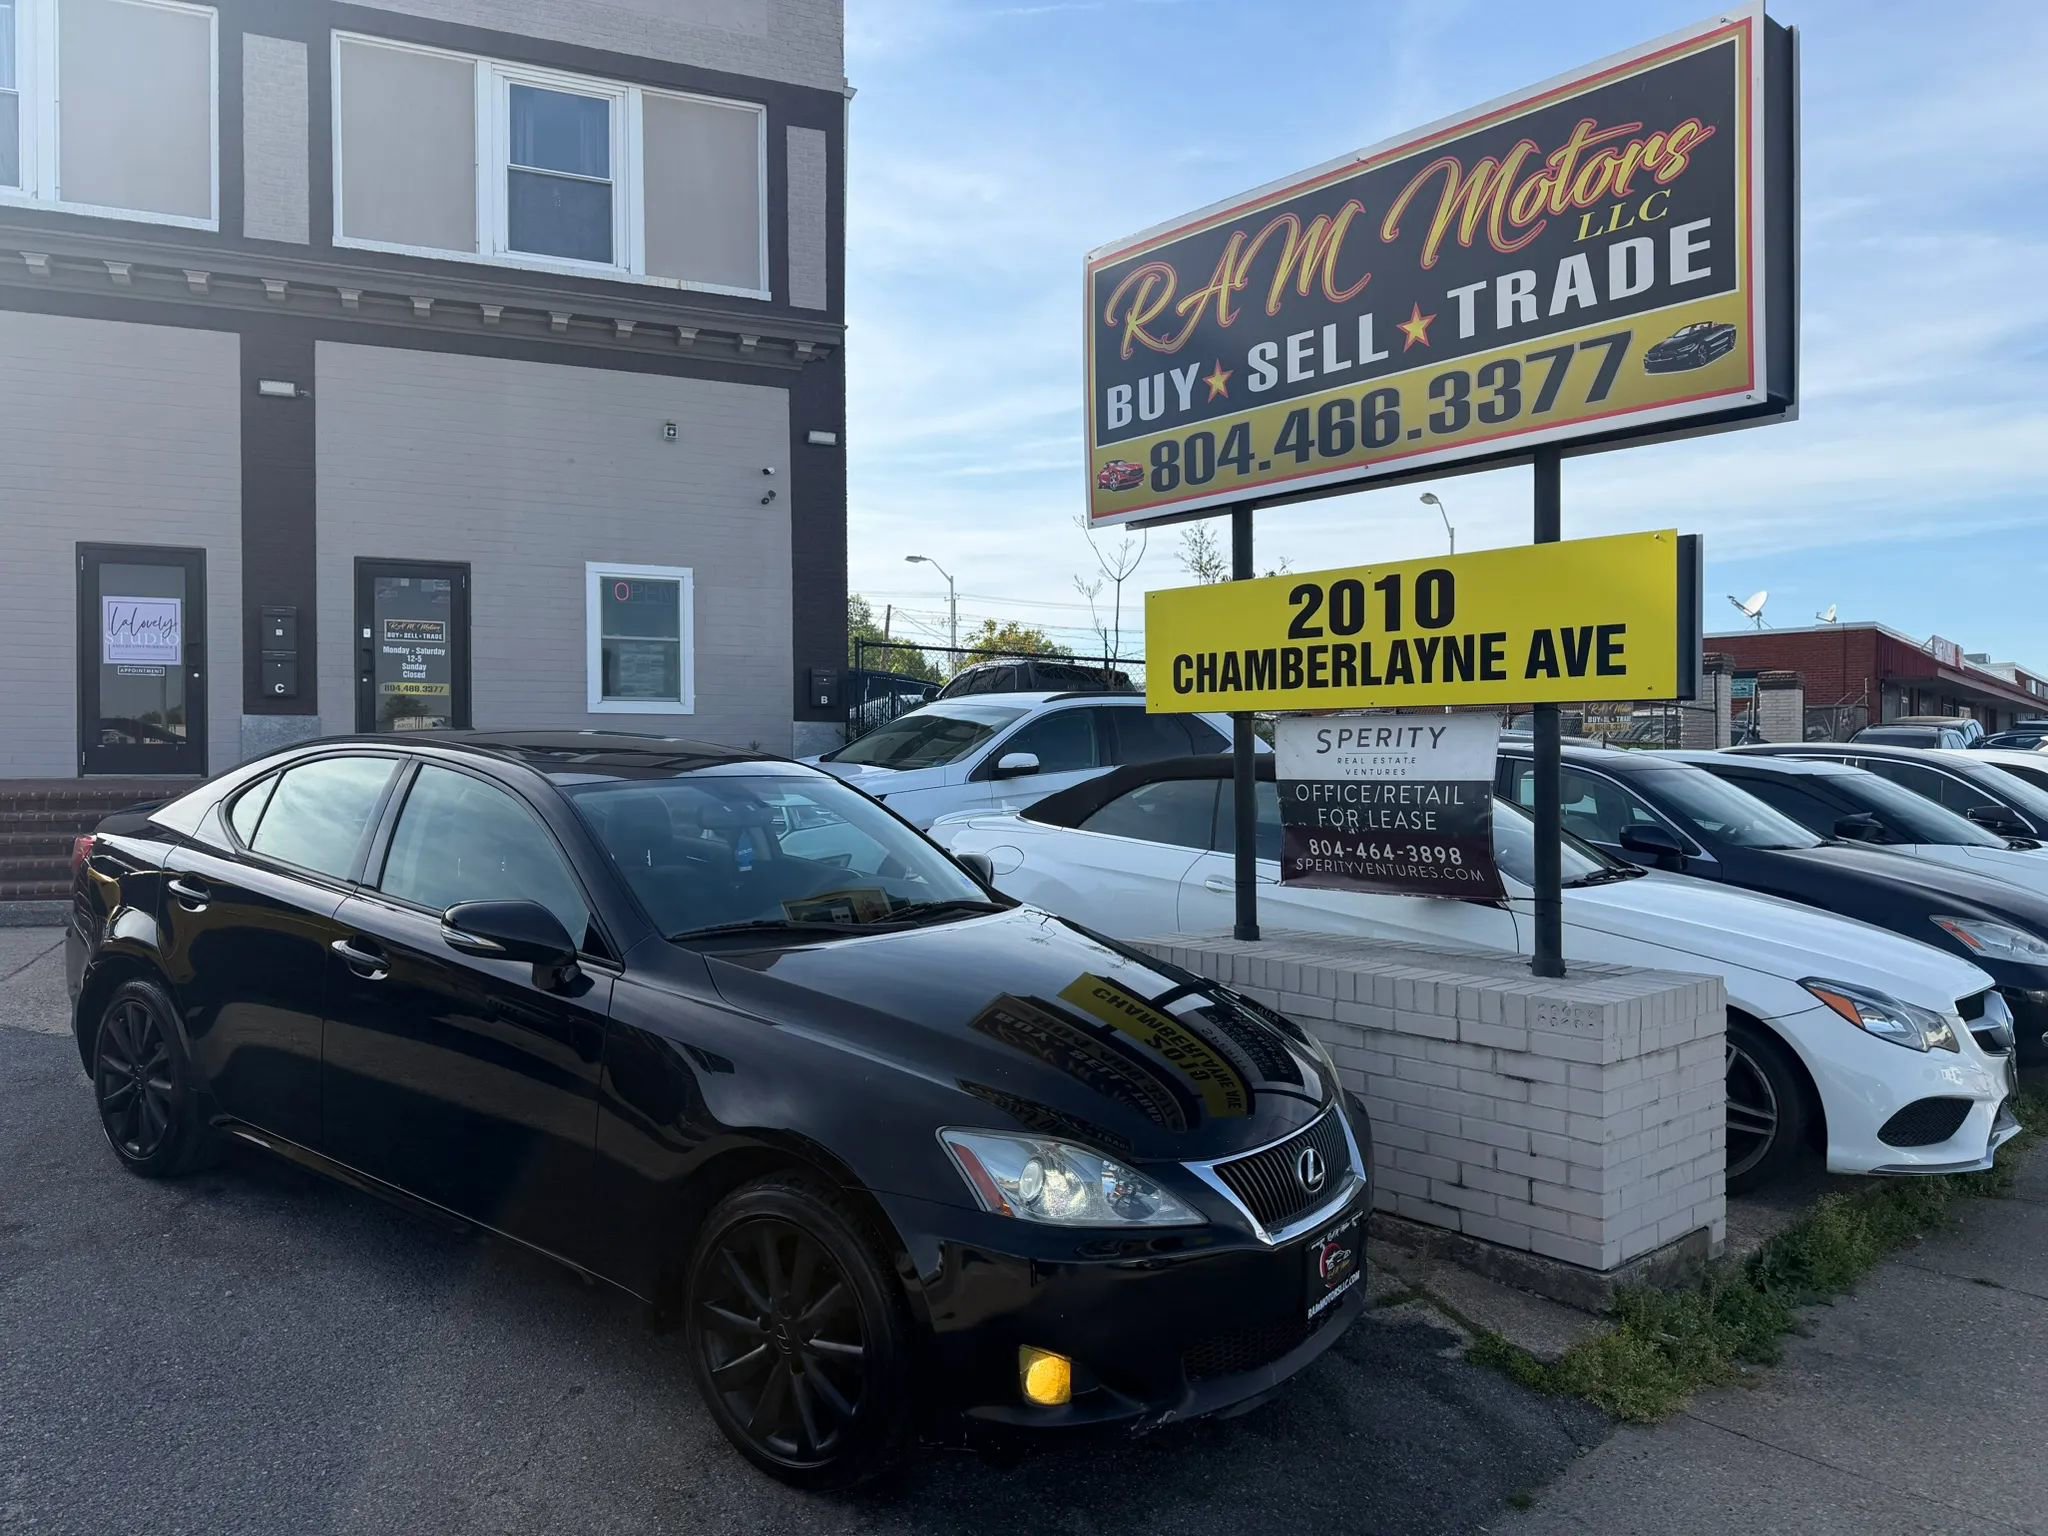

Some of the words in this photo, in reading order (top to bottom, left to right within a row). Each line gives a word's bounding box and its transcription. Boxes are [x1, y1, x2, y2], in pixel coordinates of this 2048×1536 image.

[1573, 189, 1671, 242] LLC
[1104, 200, 1372, 360] RAM
[1380, 117, 1716, 270] Motors
[1107, 362, 1201, 430] BUY
[1248, 313, 1389, 393] SELL
[1446, 217, 1712, 339] TRADE
[1149, 328, 1634, 494] 804.466.3377
[1286, 568, 1456, 640] 2010
[382, 645, 410, 655] Monday
[415, 647, 446, 656] Saturday
[1172, 631, 1507, 694] CHAMBERLAYNE
[1523, 623, 1628, 679] AVE
[401, 662, 427, 671] Sunday
[402, 670, 426, 678] Closed
[275, 683, 285, 693] C
[1316, 726, 1447, 754] SPERITY
[1337, 757, 1365, 765] REAL
[1372, 756, 1417, 765] ESTATE
[1345, 768, 1407, 776] VENTURES
[1295, 784, 1464, 805] OFFICE/RETAIL
[1317, 808, 1359, 828] FOR
[1368, 810, 1437, 830] LEASE
[1308, 838, 1463, 866] 804-464-3898
[1295, 858, 1485, 882] SPERITYVENTURES.COM
